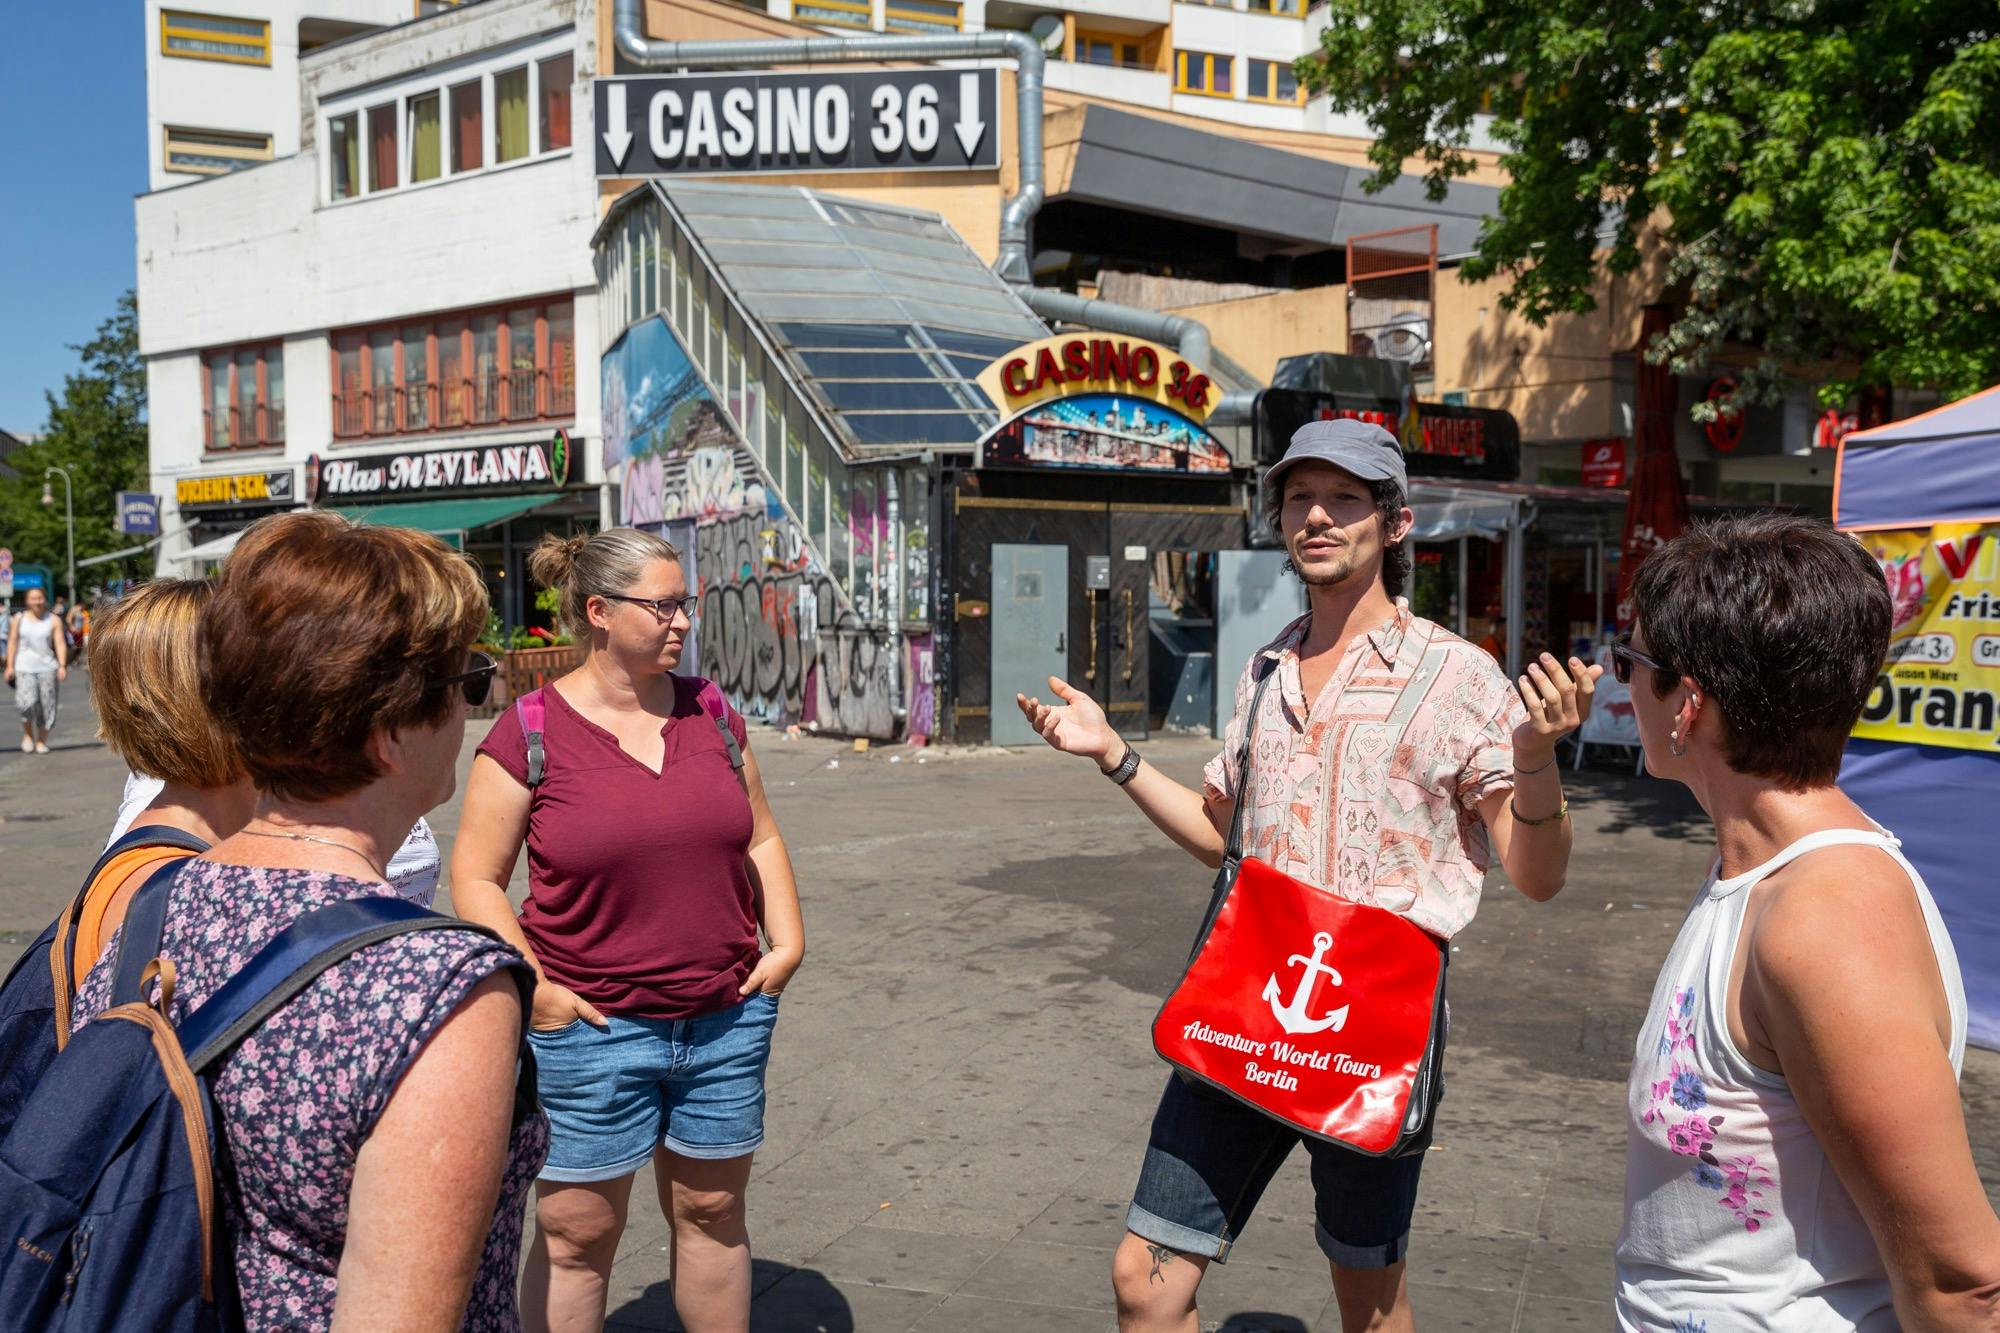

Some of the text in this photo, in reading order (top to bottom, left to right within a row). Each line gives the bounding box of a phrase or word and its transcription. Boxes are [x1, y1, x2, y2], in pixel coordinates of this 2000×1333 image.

[648, 82, 940, 160] CASINO 36
[1001, 339, 1211, 409] CASINO 36
[323, 459, 386, 494] Has
[388, 443, 550, 490] MEVLANA
[1183, 1020, 1382, 1080] Adventure World Tours
[1244, 1061, 1299, 1093] Berlin
